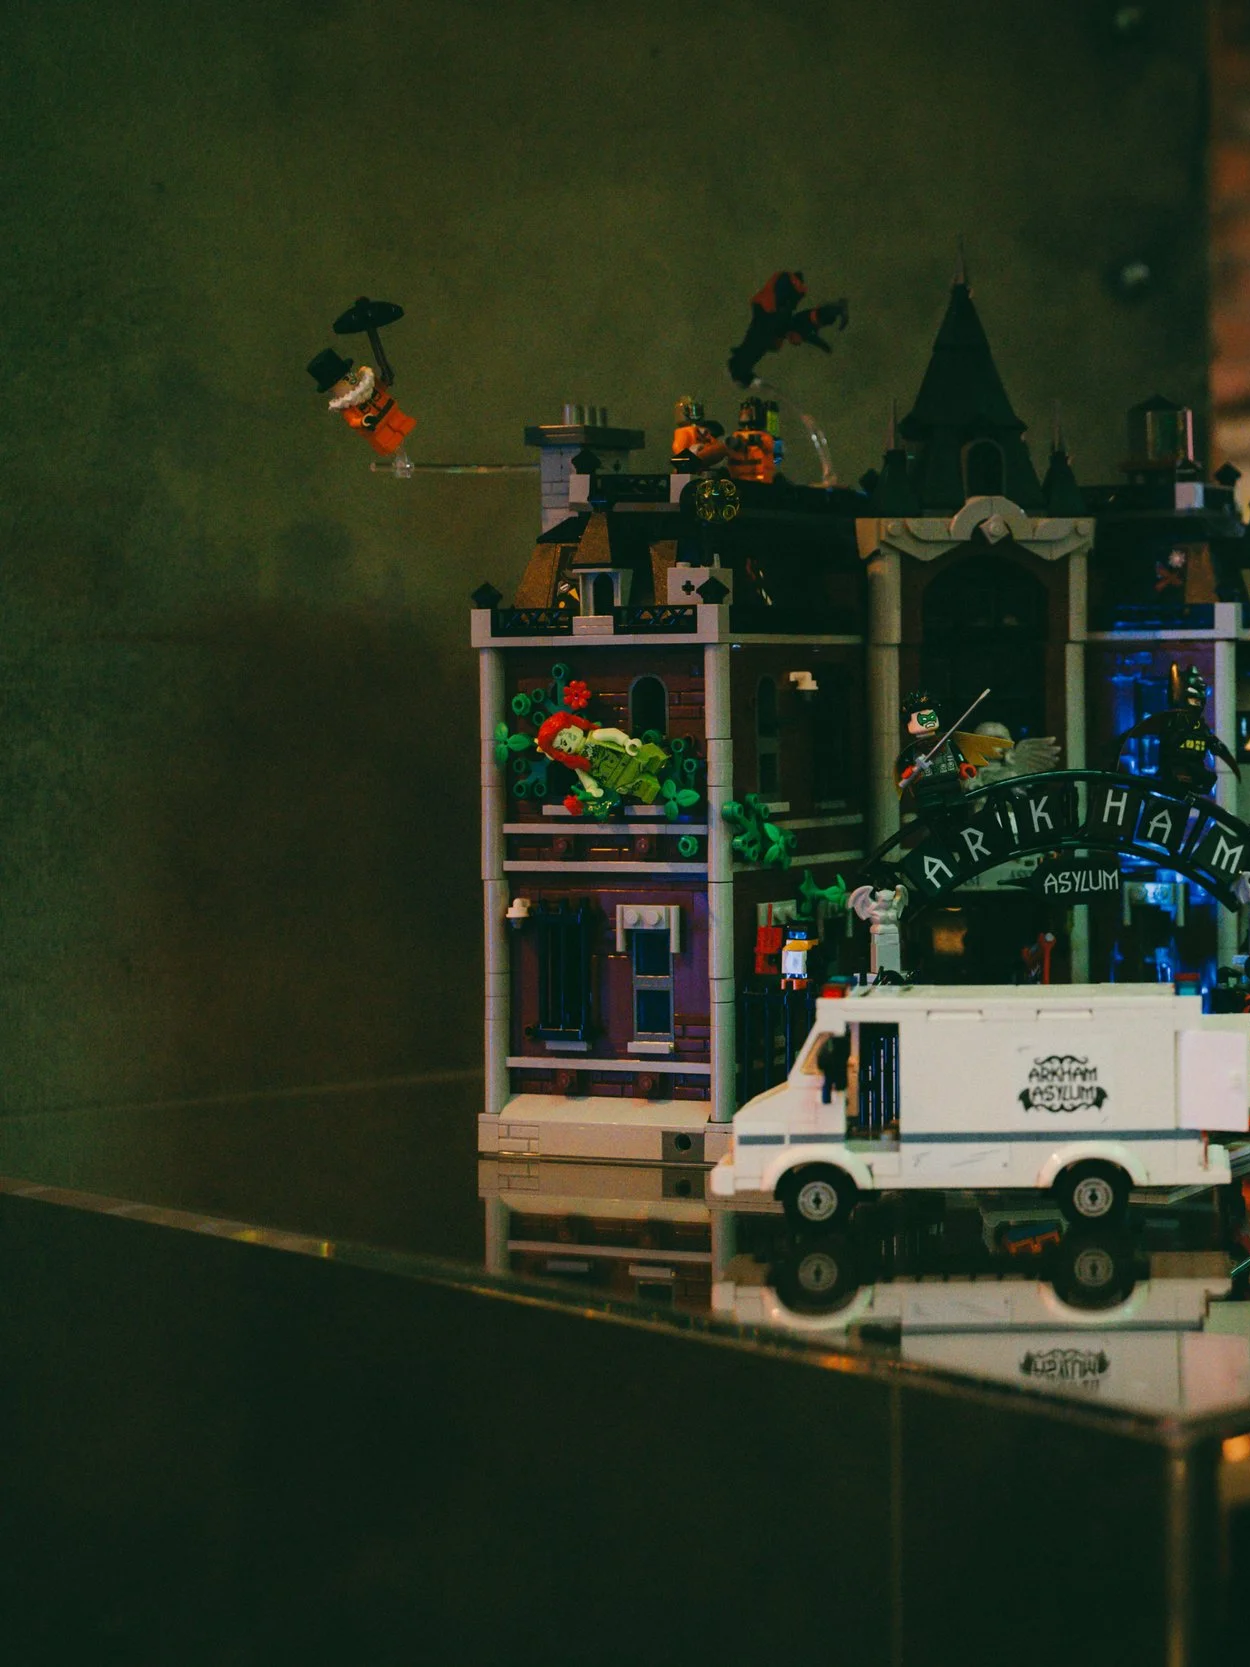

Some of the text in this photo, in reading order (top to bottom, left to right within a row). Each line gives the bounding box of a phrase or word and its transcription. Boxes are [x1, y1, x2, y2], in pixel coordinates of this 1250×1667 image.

[923, 788, 1245, 889] ARKHAM
[1044, 869, 1119, 895] ASYLUM
[1028, 1066, 1097, 1082] ARKHAM
[1032, 1085, 1095, 1102] ASYLUM
